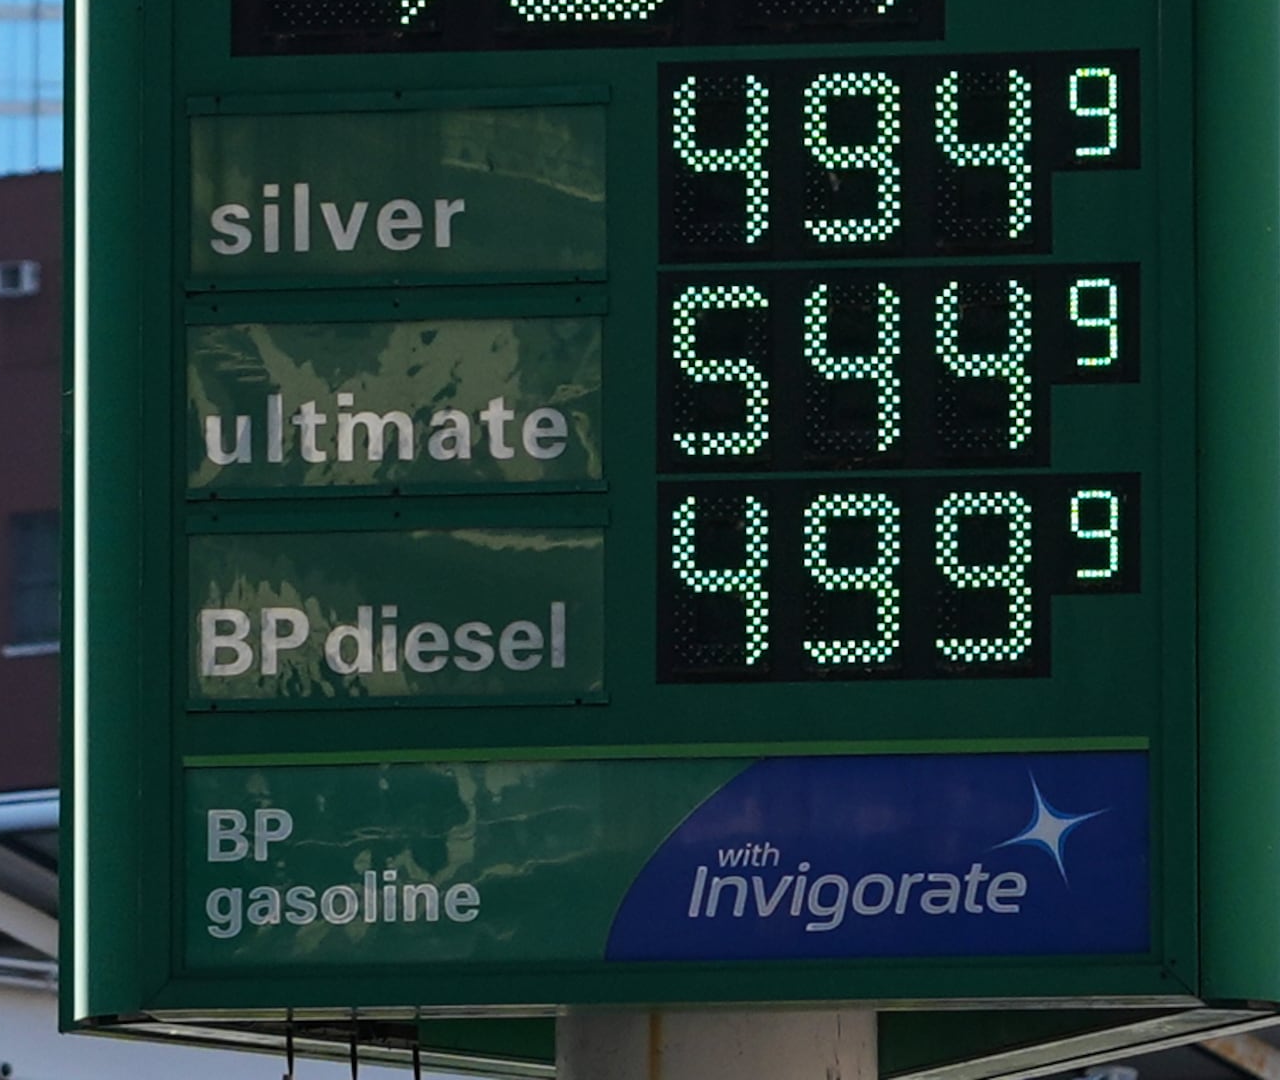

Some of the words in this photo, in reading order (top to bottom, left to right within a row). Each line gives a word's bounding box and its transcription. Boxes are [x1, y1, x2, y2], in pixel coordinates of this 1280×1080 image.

[210, 183, 466, 255] silver
[204, 393, 568, 466] ultimate
[199, 607, 312, 678] BP
[324, 602, 566, 675] diesel
[206, 808, 294, 863] BP
[717, 842, 781, 867] with
[205, 869, 482, 938] gasoline
[686, 862, 1028, 932] Invigorate
